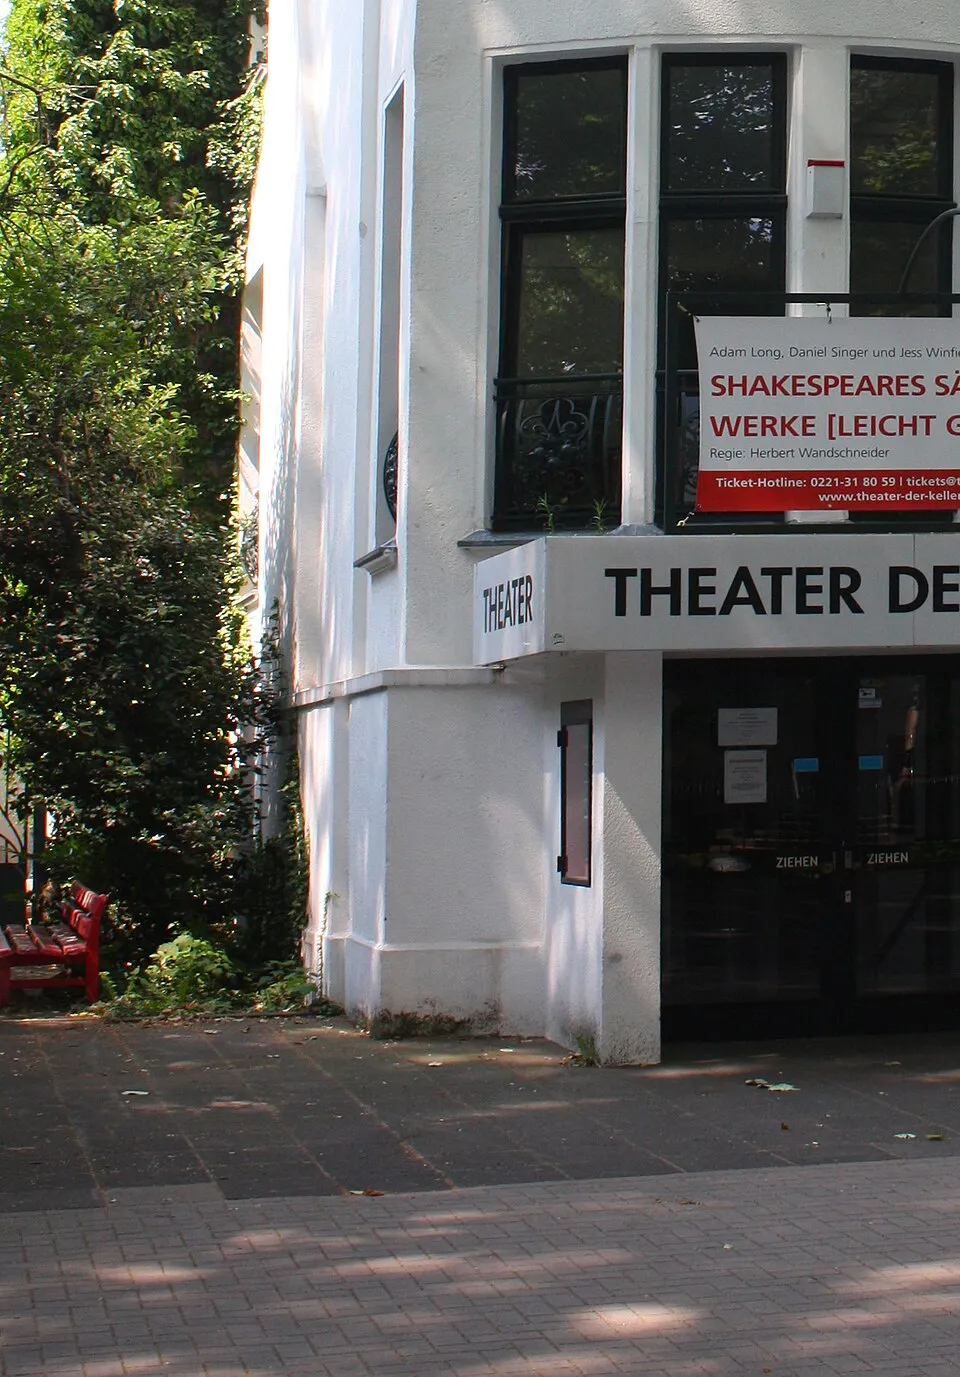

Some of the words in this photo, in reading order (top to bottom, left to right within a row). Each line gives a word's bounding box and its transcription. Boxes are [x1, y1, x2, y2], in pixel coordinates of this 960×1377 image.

[710, 347, 746, 357] Adam
[752, 347, 784, 360] Long,
[790, 347, 826, 357] Daniel
[832, 347, 868, 360] Singer
[873, 347, 895, 357] und
[900, 348, 922, 357] Jess
[711, 375, 925, 396] SHAKESPEARES
[710, 416, 816, 436] WERKE
[829, 414, 936, 440] [LEICHT
[710, 448, 745, 461] Regie:
[751, 448, 794, 458] Herbert
[799, 447, 889, 458] Wandschneider
[716, 478, 806, 487] Ticket-Hotline:
[811, 478, 857, 487] 0221-31
[863, 478, 877, 486] 80
[882, 477, 895, 486] 59
[605, 566, 864, 616] THEATER
[484, 575, 532, 633] THEATER
[776, 856, 817, 867] ZIEHEN
[868, 852, 908, 864] ZIEHEN
